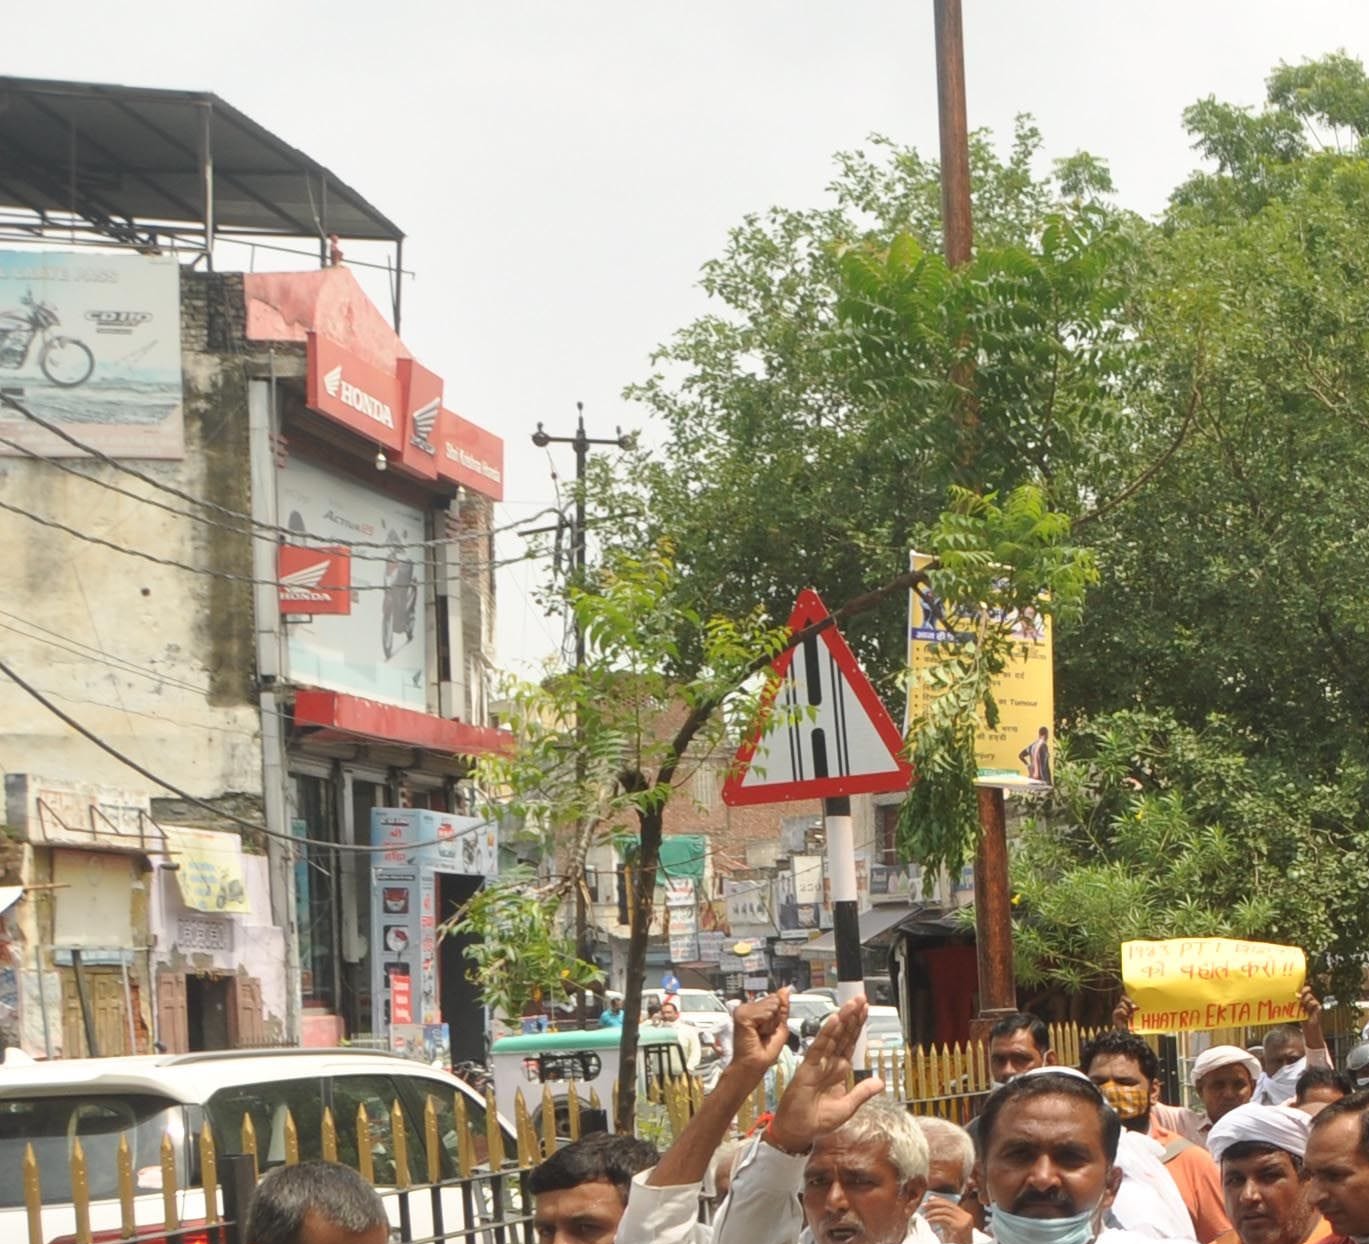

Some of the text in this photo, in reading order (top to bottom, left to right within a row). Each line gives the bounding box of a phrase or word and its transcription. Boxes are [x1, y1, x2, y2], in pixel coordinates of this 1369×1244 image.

[340, 379, 395, 430] HONDA
[280, 590, 332, 601] HONDA
[1205, 1002, 1251, 1028] EKTA
